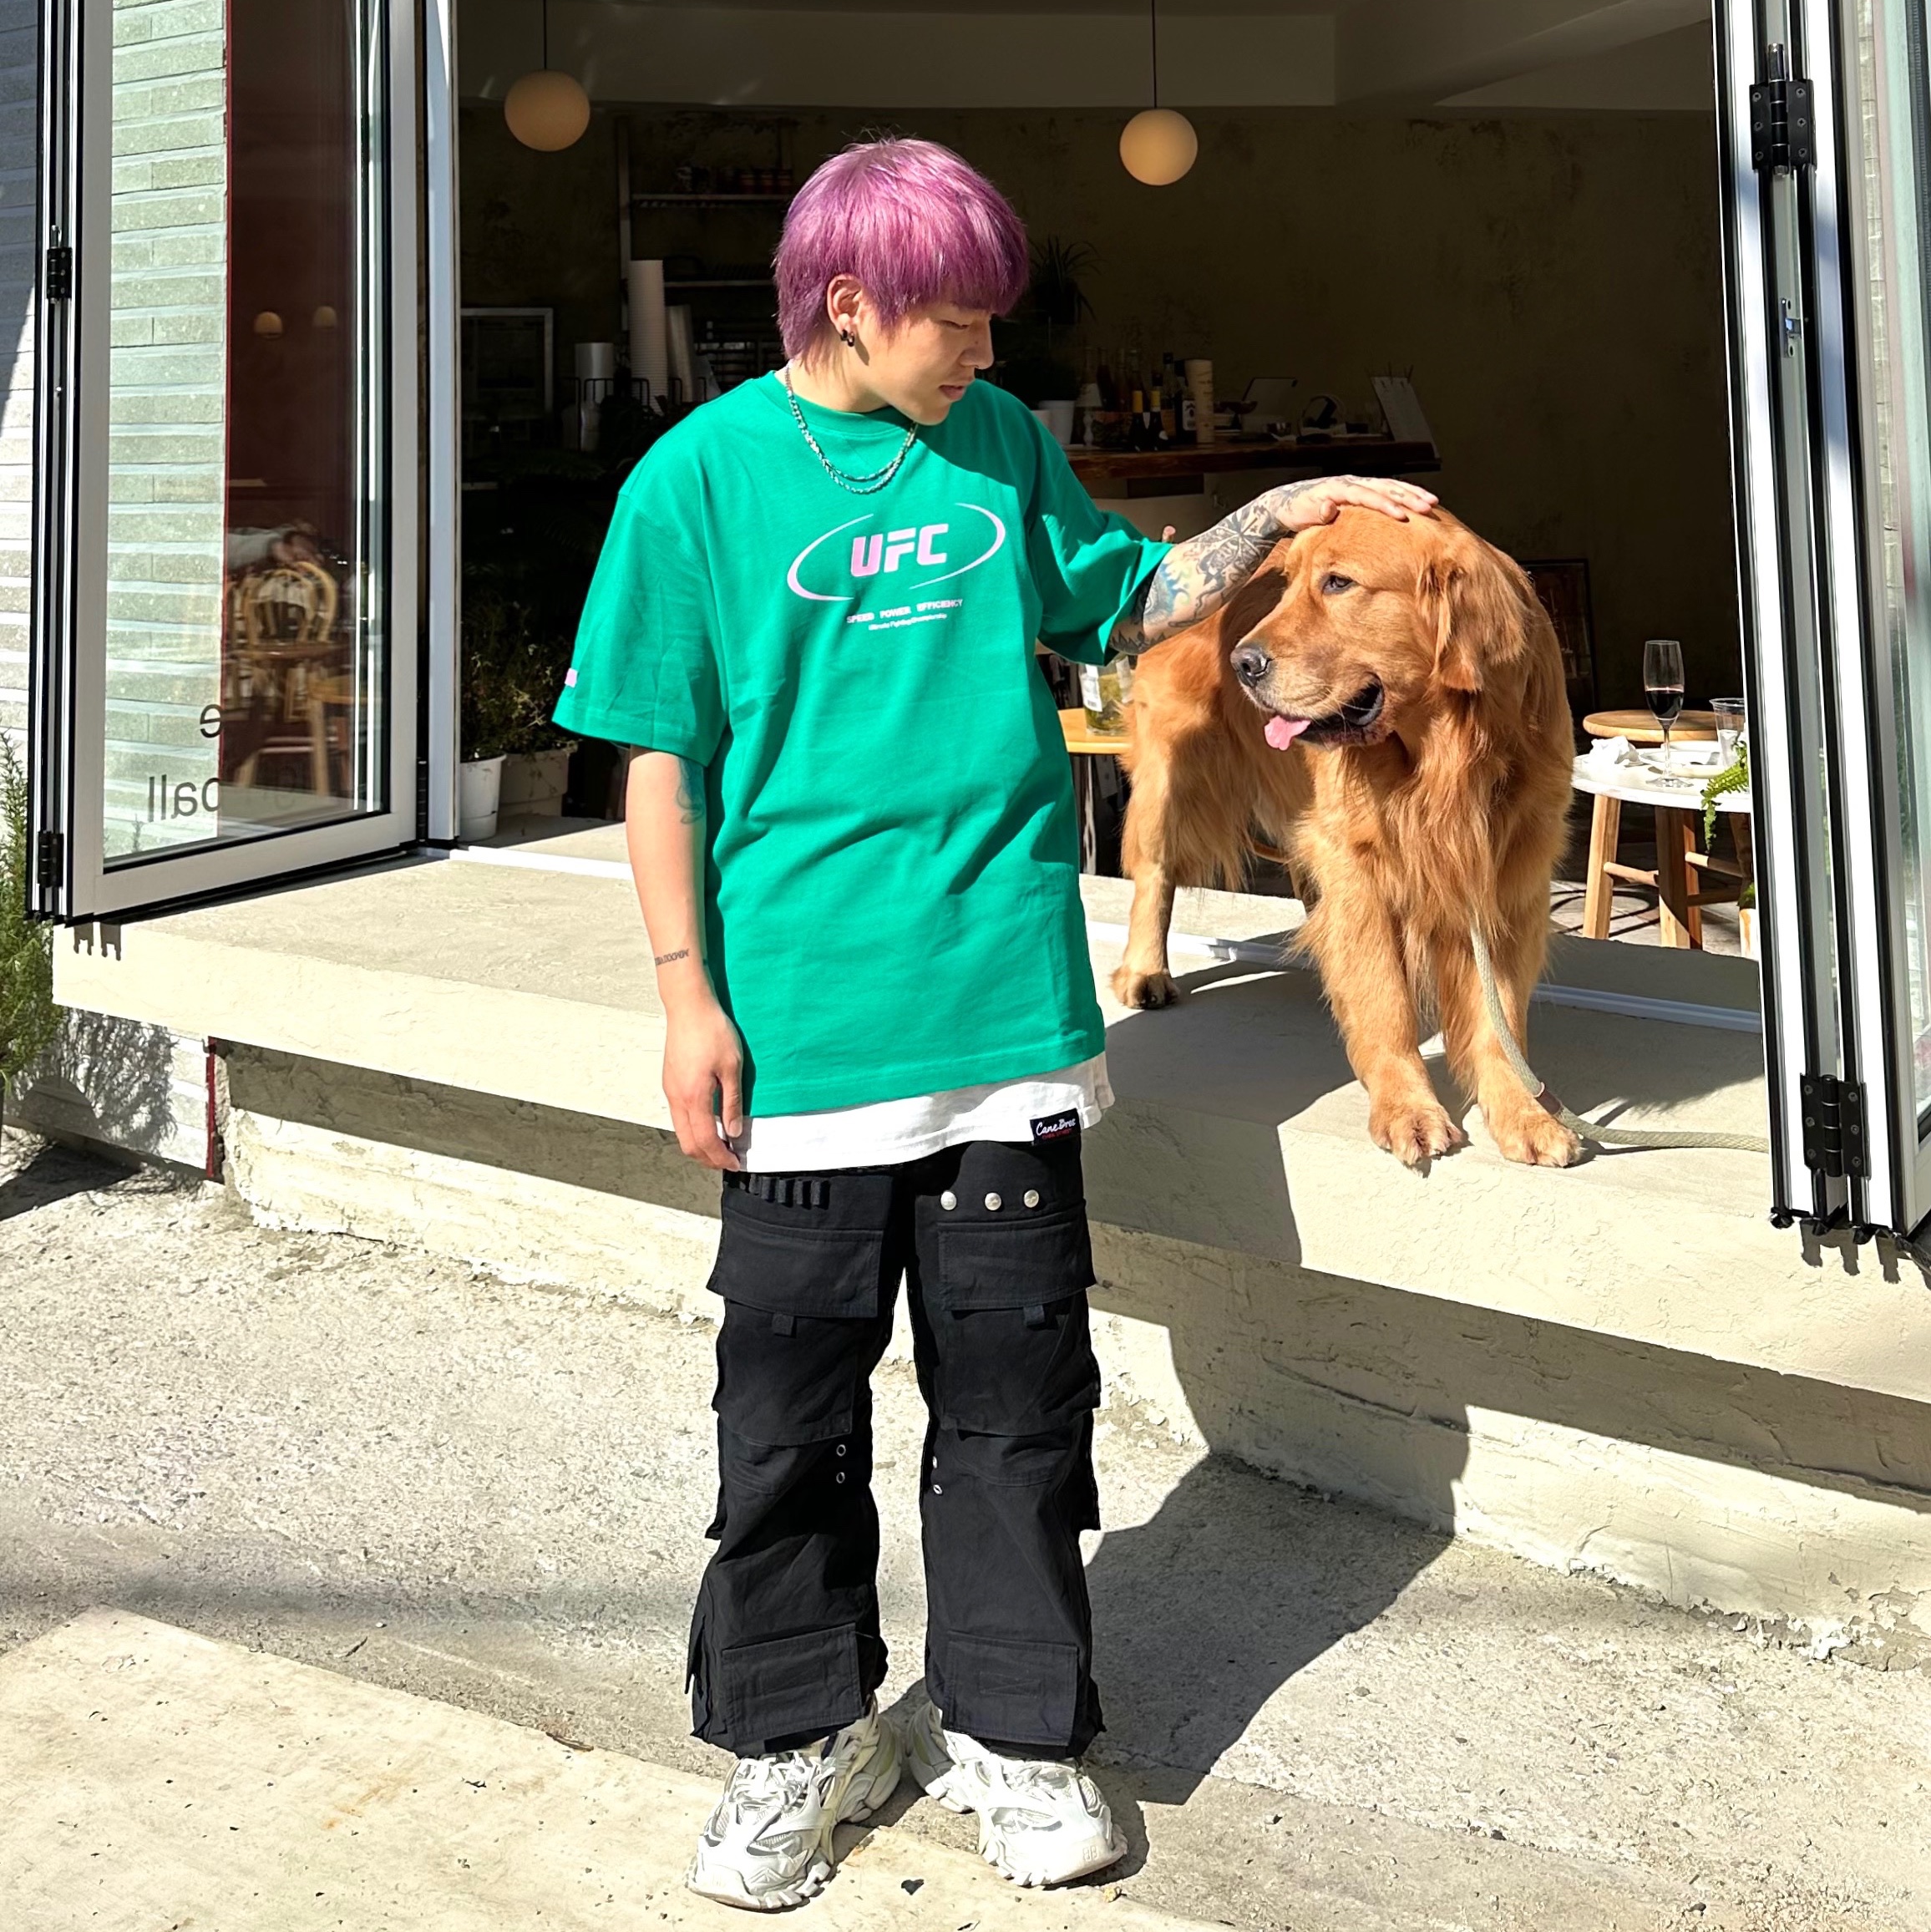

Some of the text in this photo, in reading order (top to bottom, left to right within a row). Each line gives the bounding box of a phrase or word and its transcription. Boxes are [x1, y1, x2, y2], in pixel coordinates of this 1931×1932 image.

[849, 522, 949, 577] UFC
[846, 598, 963, 623] SPEED POWER EFFICIENCY
